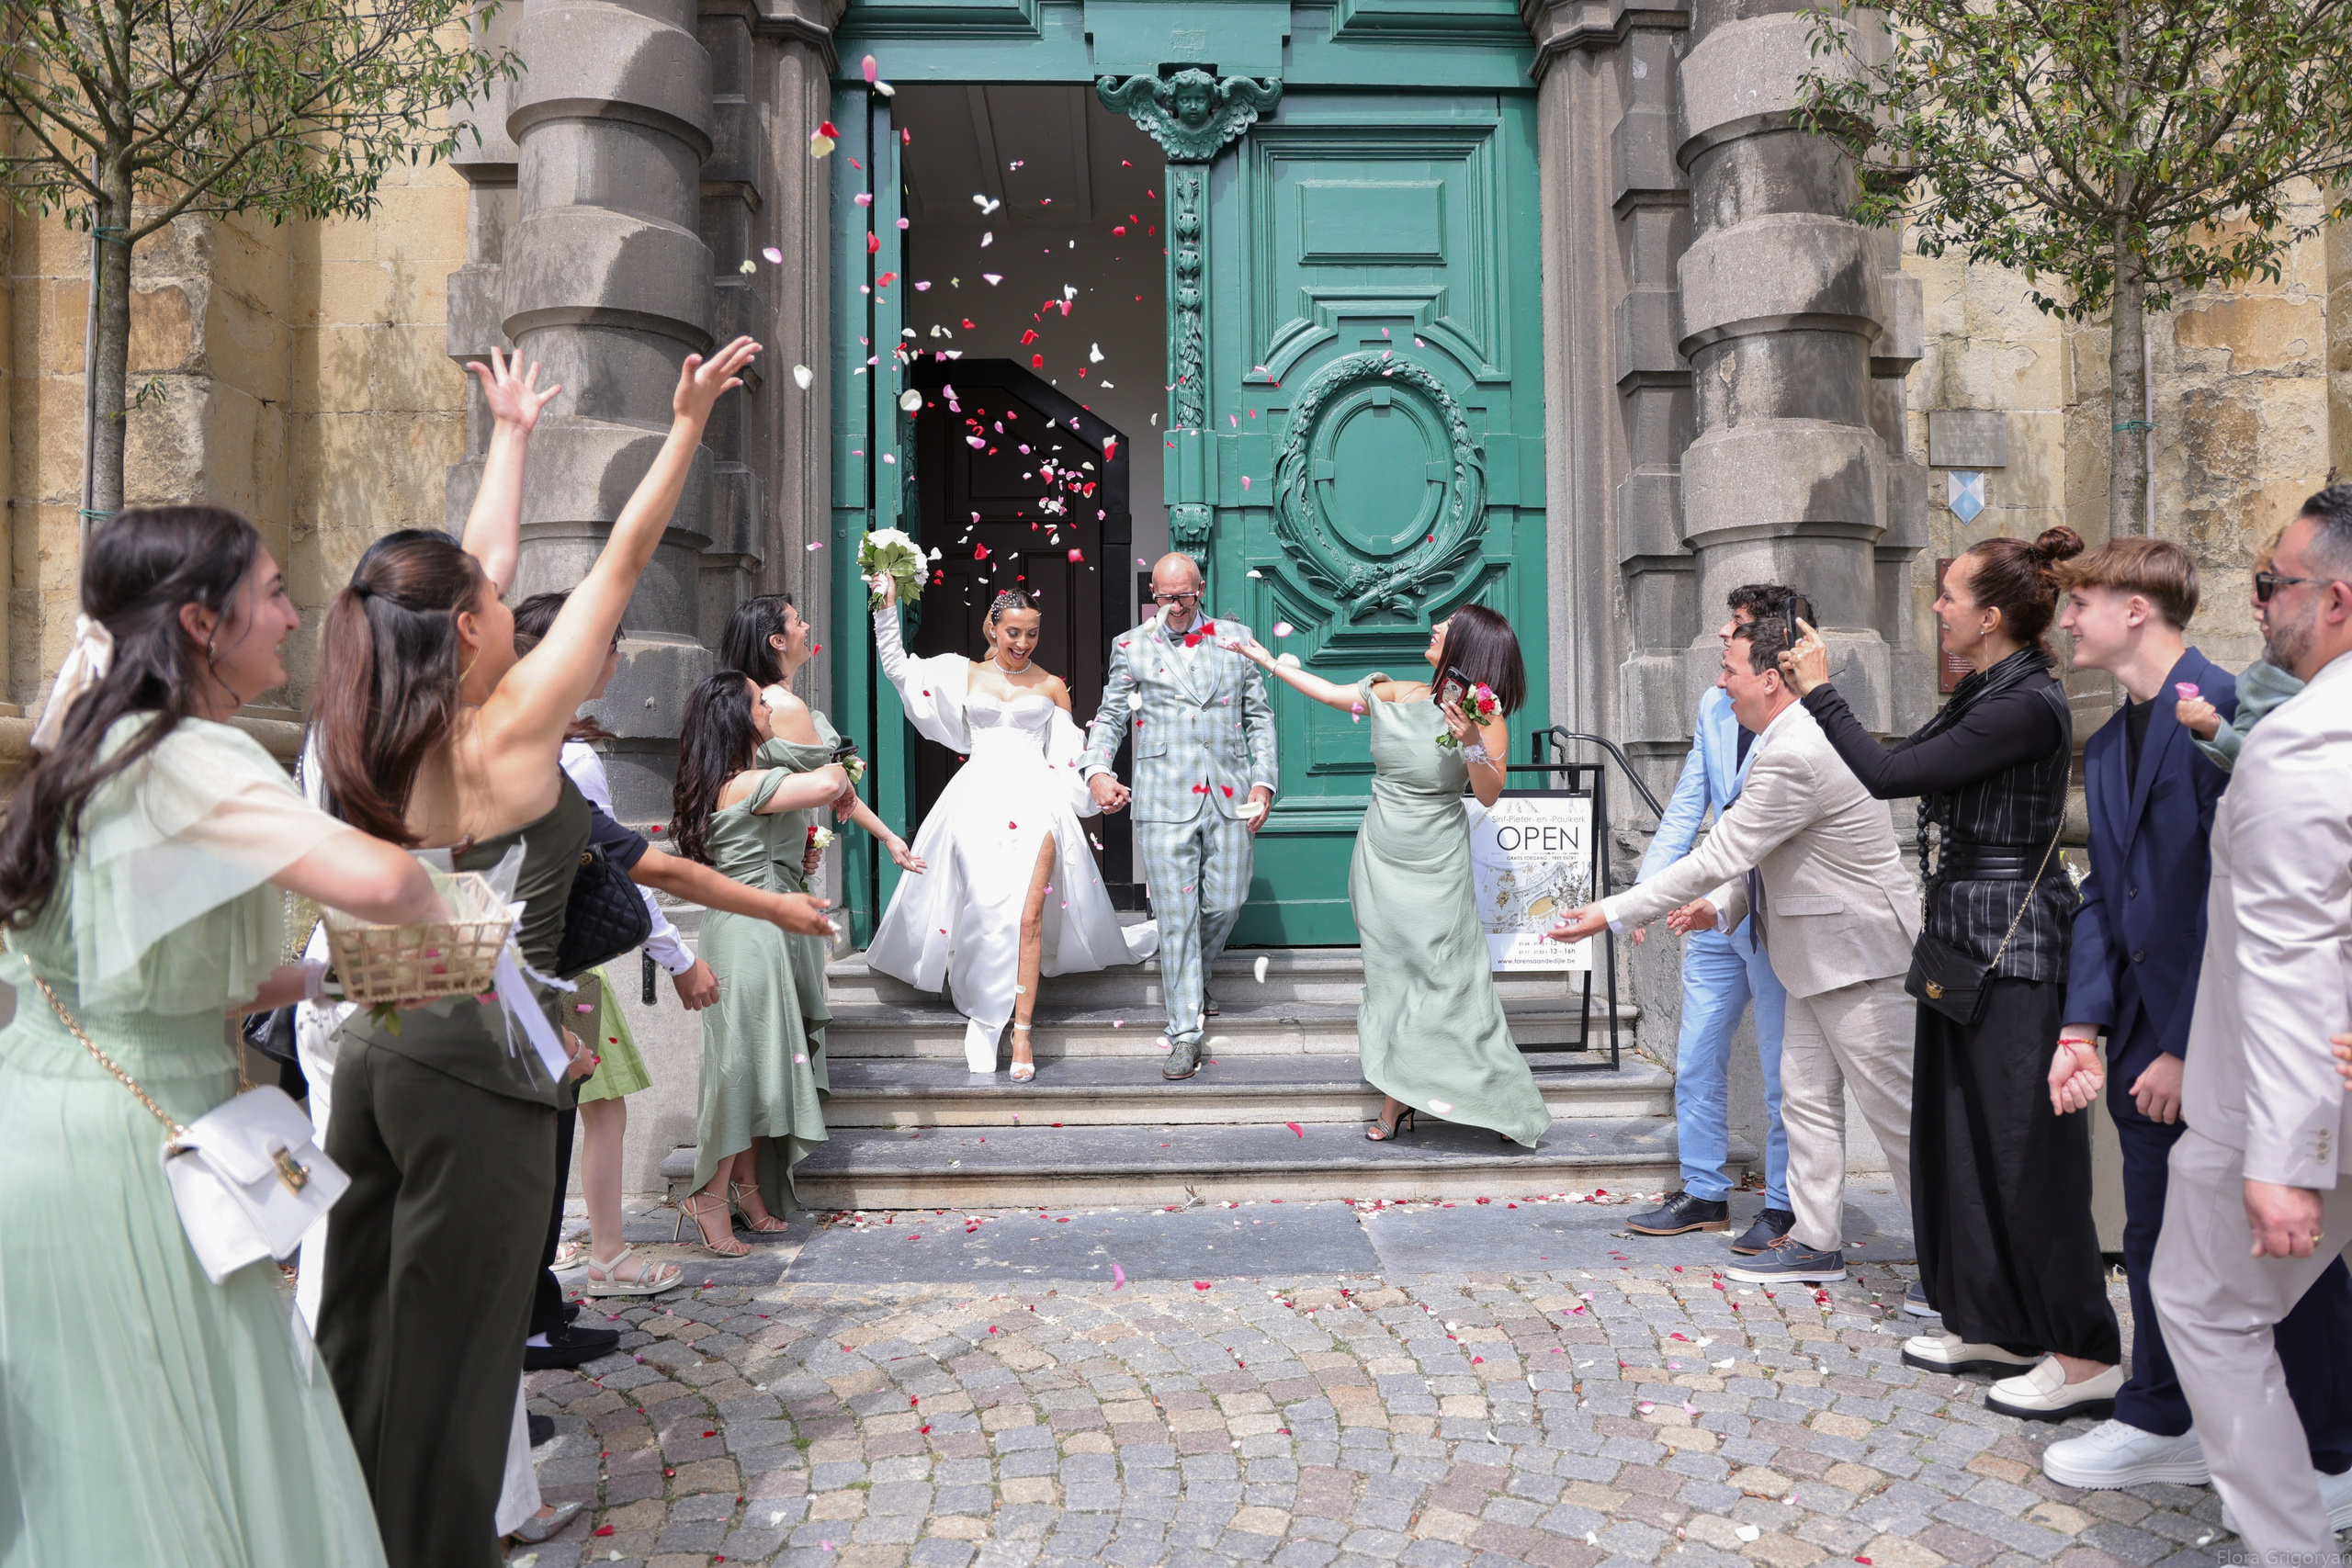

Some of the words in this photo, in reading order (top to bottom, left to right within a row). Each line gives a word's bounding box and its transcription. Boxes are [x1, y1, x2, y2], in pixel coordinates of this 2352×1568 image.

[1491, 815, 1534, 823] Sint-Pieter-
[1549, 815, 1586, 823] -Paulkerk
[1497, 826, 1578, 852] OPEN
